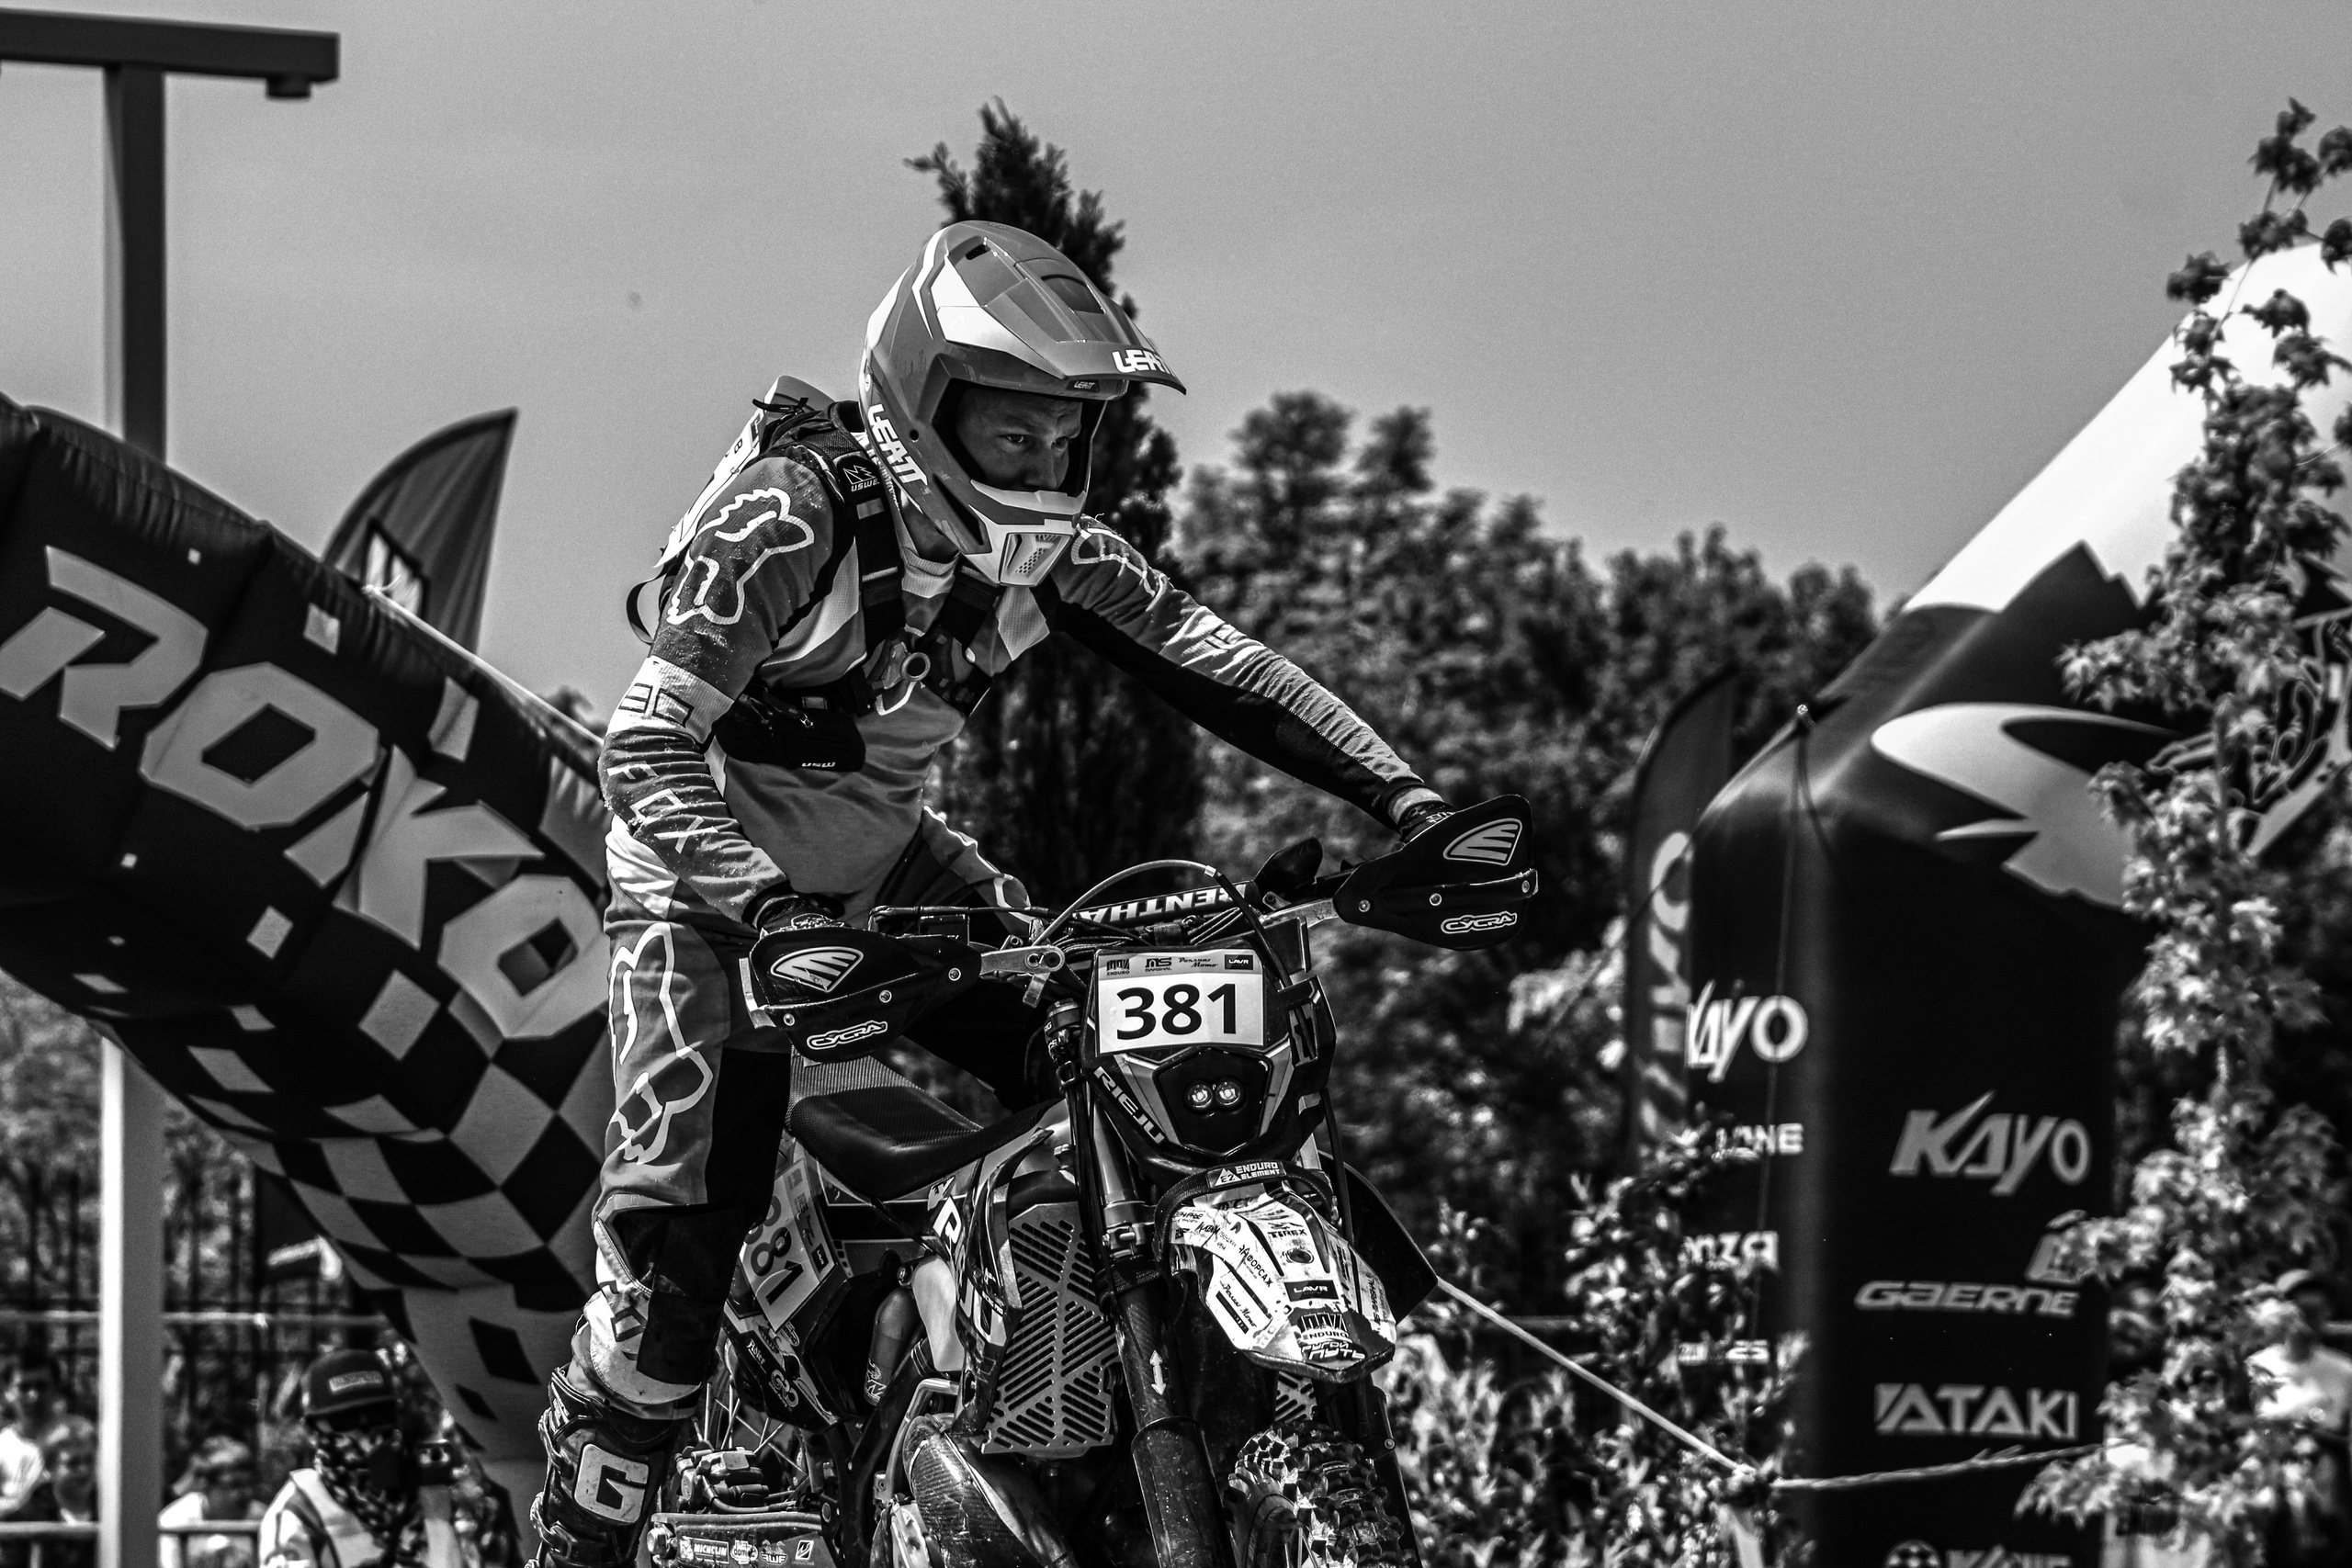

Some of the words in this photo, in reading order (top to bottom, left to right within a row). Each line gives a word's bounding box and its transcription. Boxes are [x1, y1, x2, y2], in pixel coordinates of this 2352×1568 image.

[1074, 380, 1096, 389] LEATT
[867, 403, 928, 486] LEATT
[1072, 884, 1247, 924] RENTHA
[1442, 912, 1516, 933] CYCRA
[1116, 983, 1237, 1040] 381
[808, 1021, 887, 1049] CYCRA
[1093, 1066, 1165, 1144] RIEJU
[1235, 1161, 1279, 1174] ENDURO
[1241, 1168, 1281, 1179] ELEMENT
[1293, 1285, 1329, 1293] LAVR
[747, 1338, 766, 1365] Adler
[1309, 1348, 1366, 1359] ПУТЬ
[1875, 1382, 2079, 1440] ATAKI
[694, 1543, 728, 1556] MICHELIN
